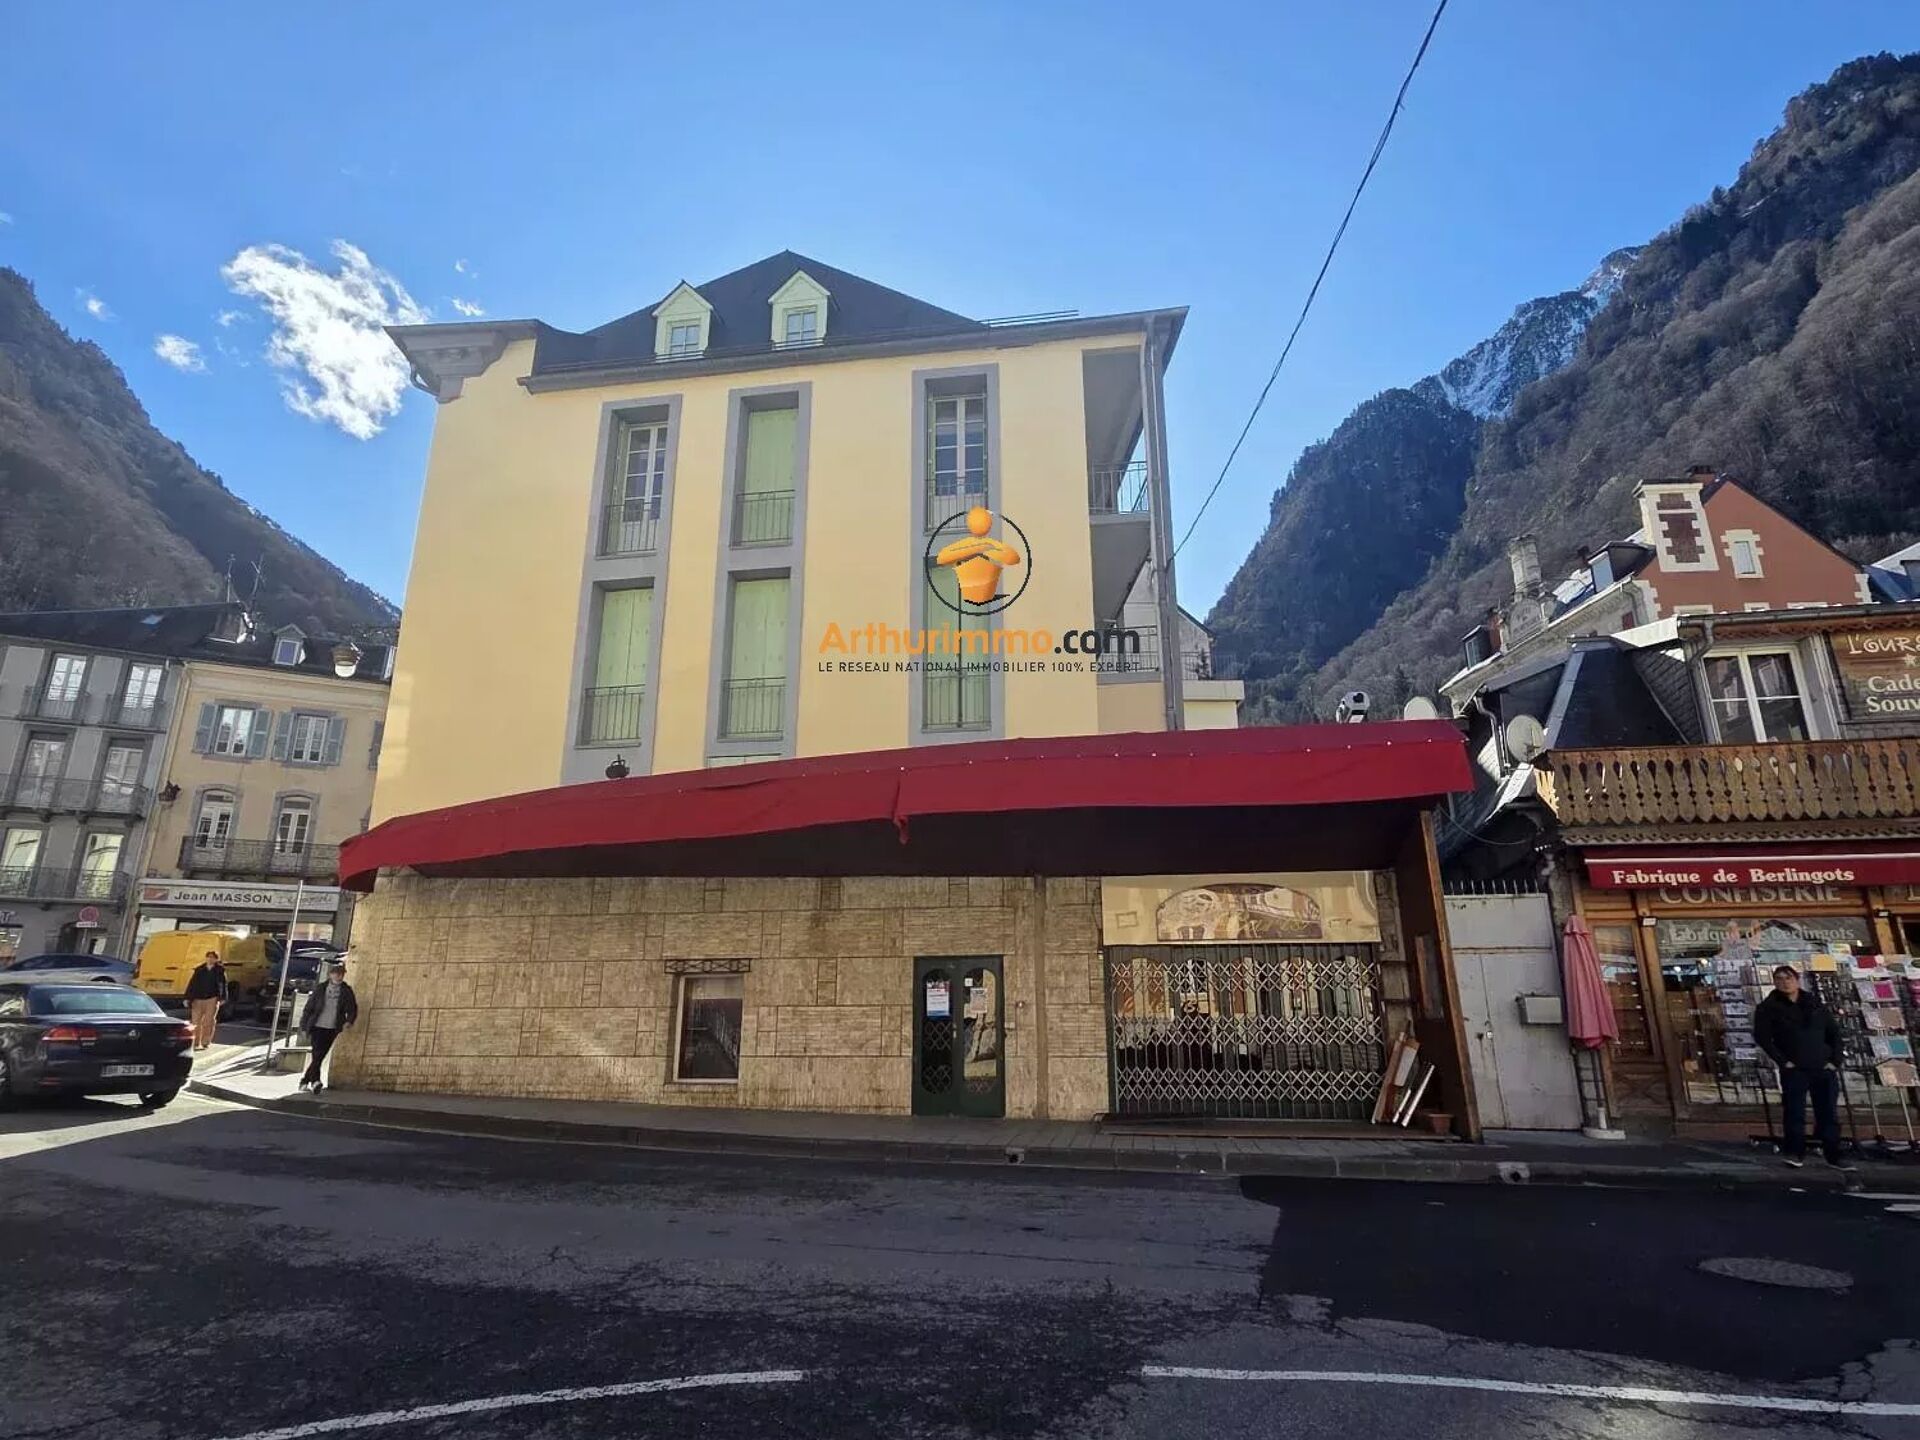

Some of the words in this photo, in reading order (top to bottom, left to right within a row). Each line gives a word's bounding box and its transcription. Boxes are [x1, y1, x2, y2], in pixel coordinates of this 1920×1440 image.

[1613, 870, 1700, 886] Fabrique
[1713, 869, 1738, 883] de
[1750, 868, 1854, 884] Berlingots
[174, 891, 207, 902] Jean
[212, 892, 273, 904] MASSON
[1659, 886, 1841, 904] CONFISERIE
